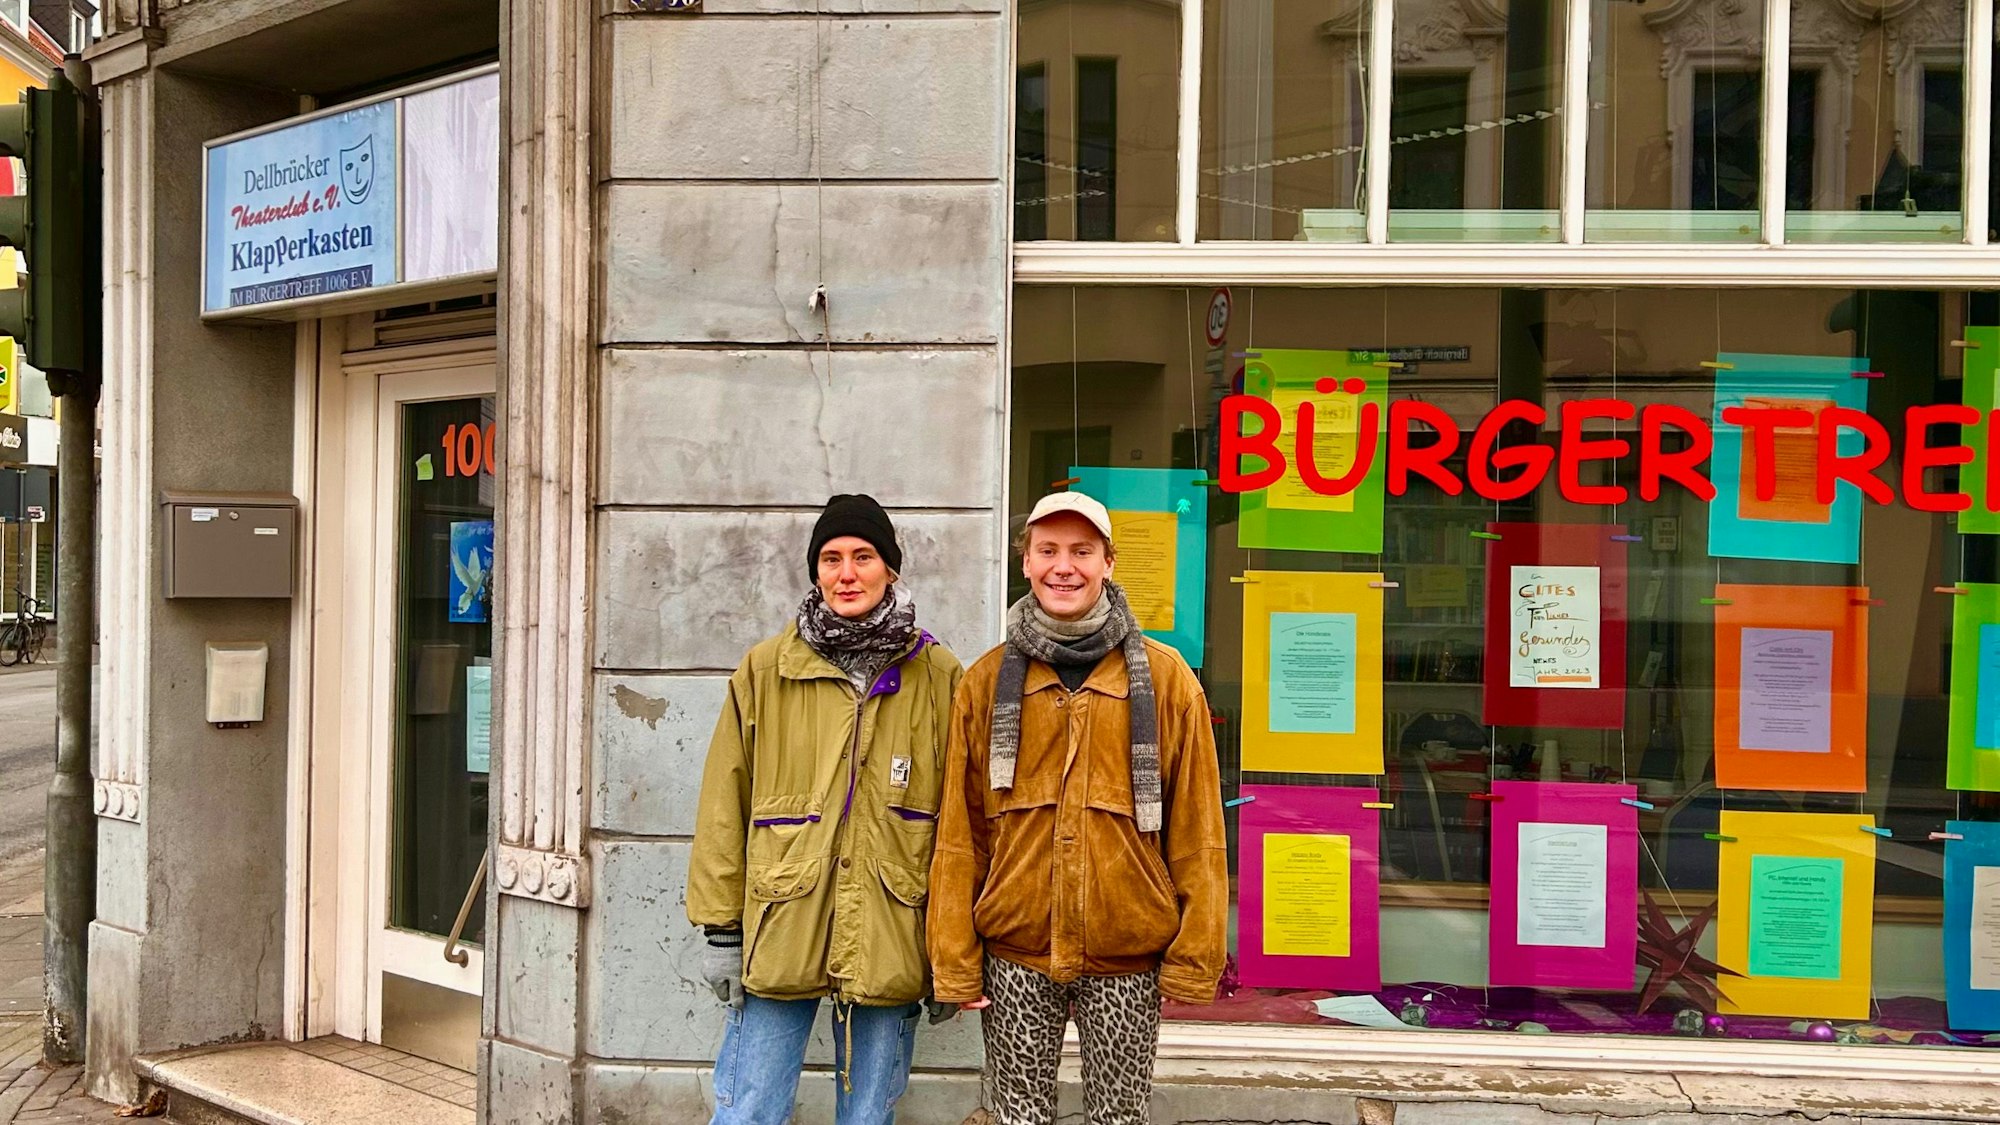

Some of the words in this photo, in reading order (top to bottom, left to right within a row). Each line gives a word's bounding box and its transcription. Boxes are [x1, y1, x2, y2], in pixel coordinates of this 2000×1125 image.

[244, 154, 330, 194] Dellbrücker
[231, 190, 311, 230] Theaterclub
[230, 292, 244, 307] IM
[245, 278, 322, 304] BÜRGERTREFF
[325, 272, 348, 291] 1006
[1219, 377, 2000, 512] BÜRGERTRE
